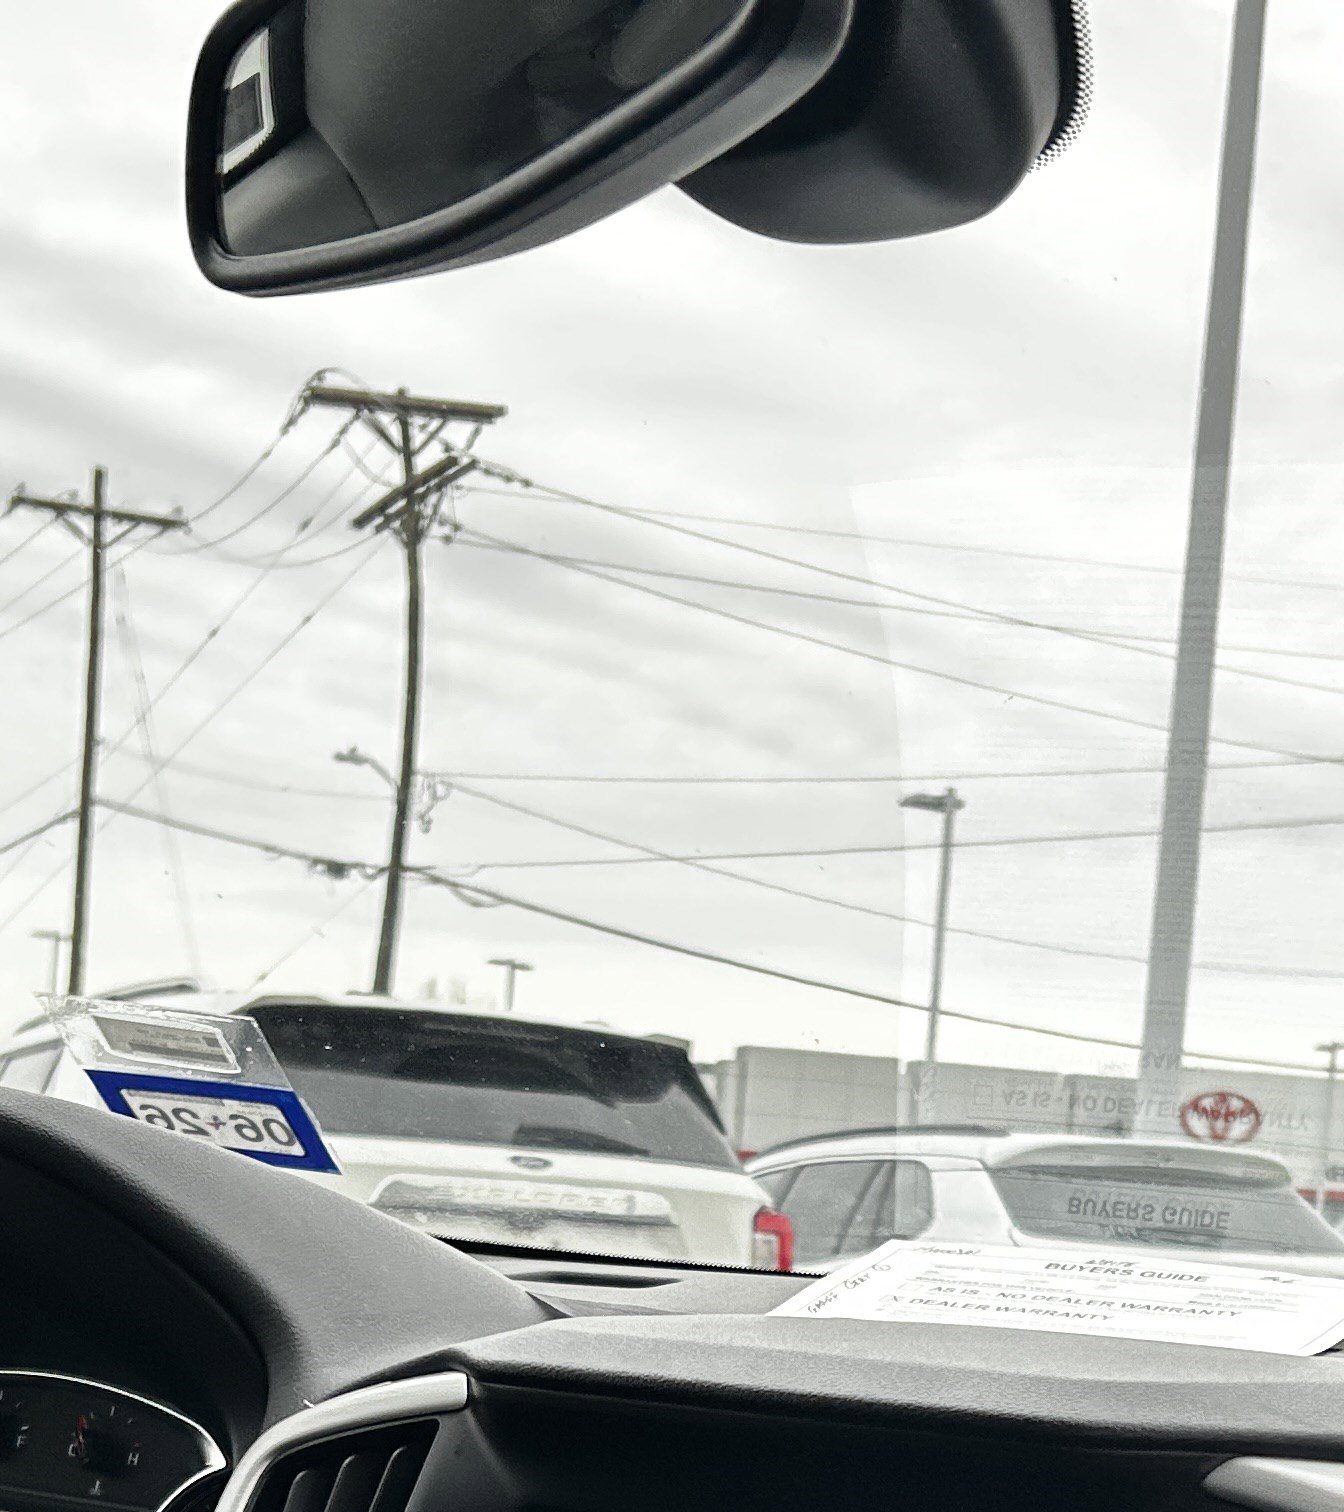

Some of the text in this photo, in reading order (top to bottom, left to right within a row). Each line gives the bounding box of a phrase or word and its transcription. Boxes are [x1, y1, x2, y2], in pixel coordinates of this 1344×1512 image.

[1044, 1262, 1134, 1276] BUYERS
[1139, 1271, 1211, 1283] GUIDE
[909, 1298, 1116, 1321] DEALER WARRANTY
[997, 1291, 1028, 1301] NO
[1030, 1293, 1117, 1308] DEALER
[1120, 1302, 1244, 1317] WARRANTY
